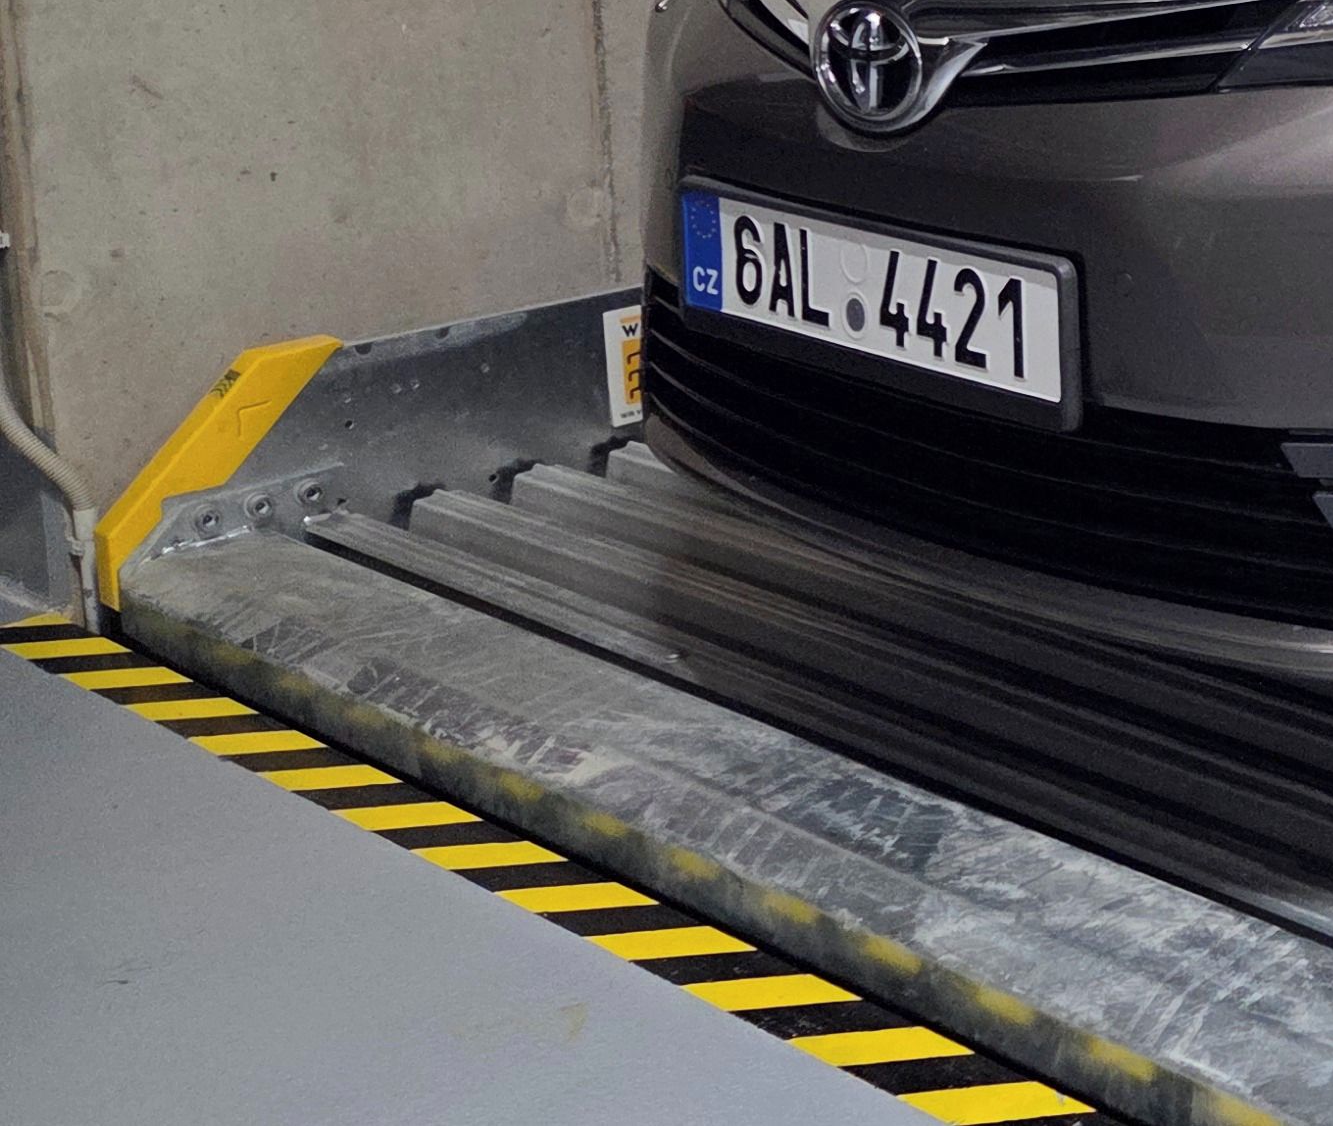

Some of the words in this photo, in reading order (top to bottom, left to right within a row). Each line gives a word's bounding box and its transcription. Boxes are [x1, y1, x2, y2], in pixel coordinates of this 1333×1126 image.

[693, 265, 718, 295] CZ
[733, 215, 830, 327] 6AL
[879, 250, 1025, 379] 4421
